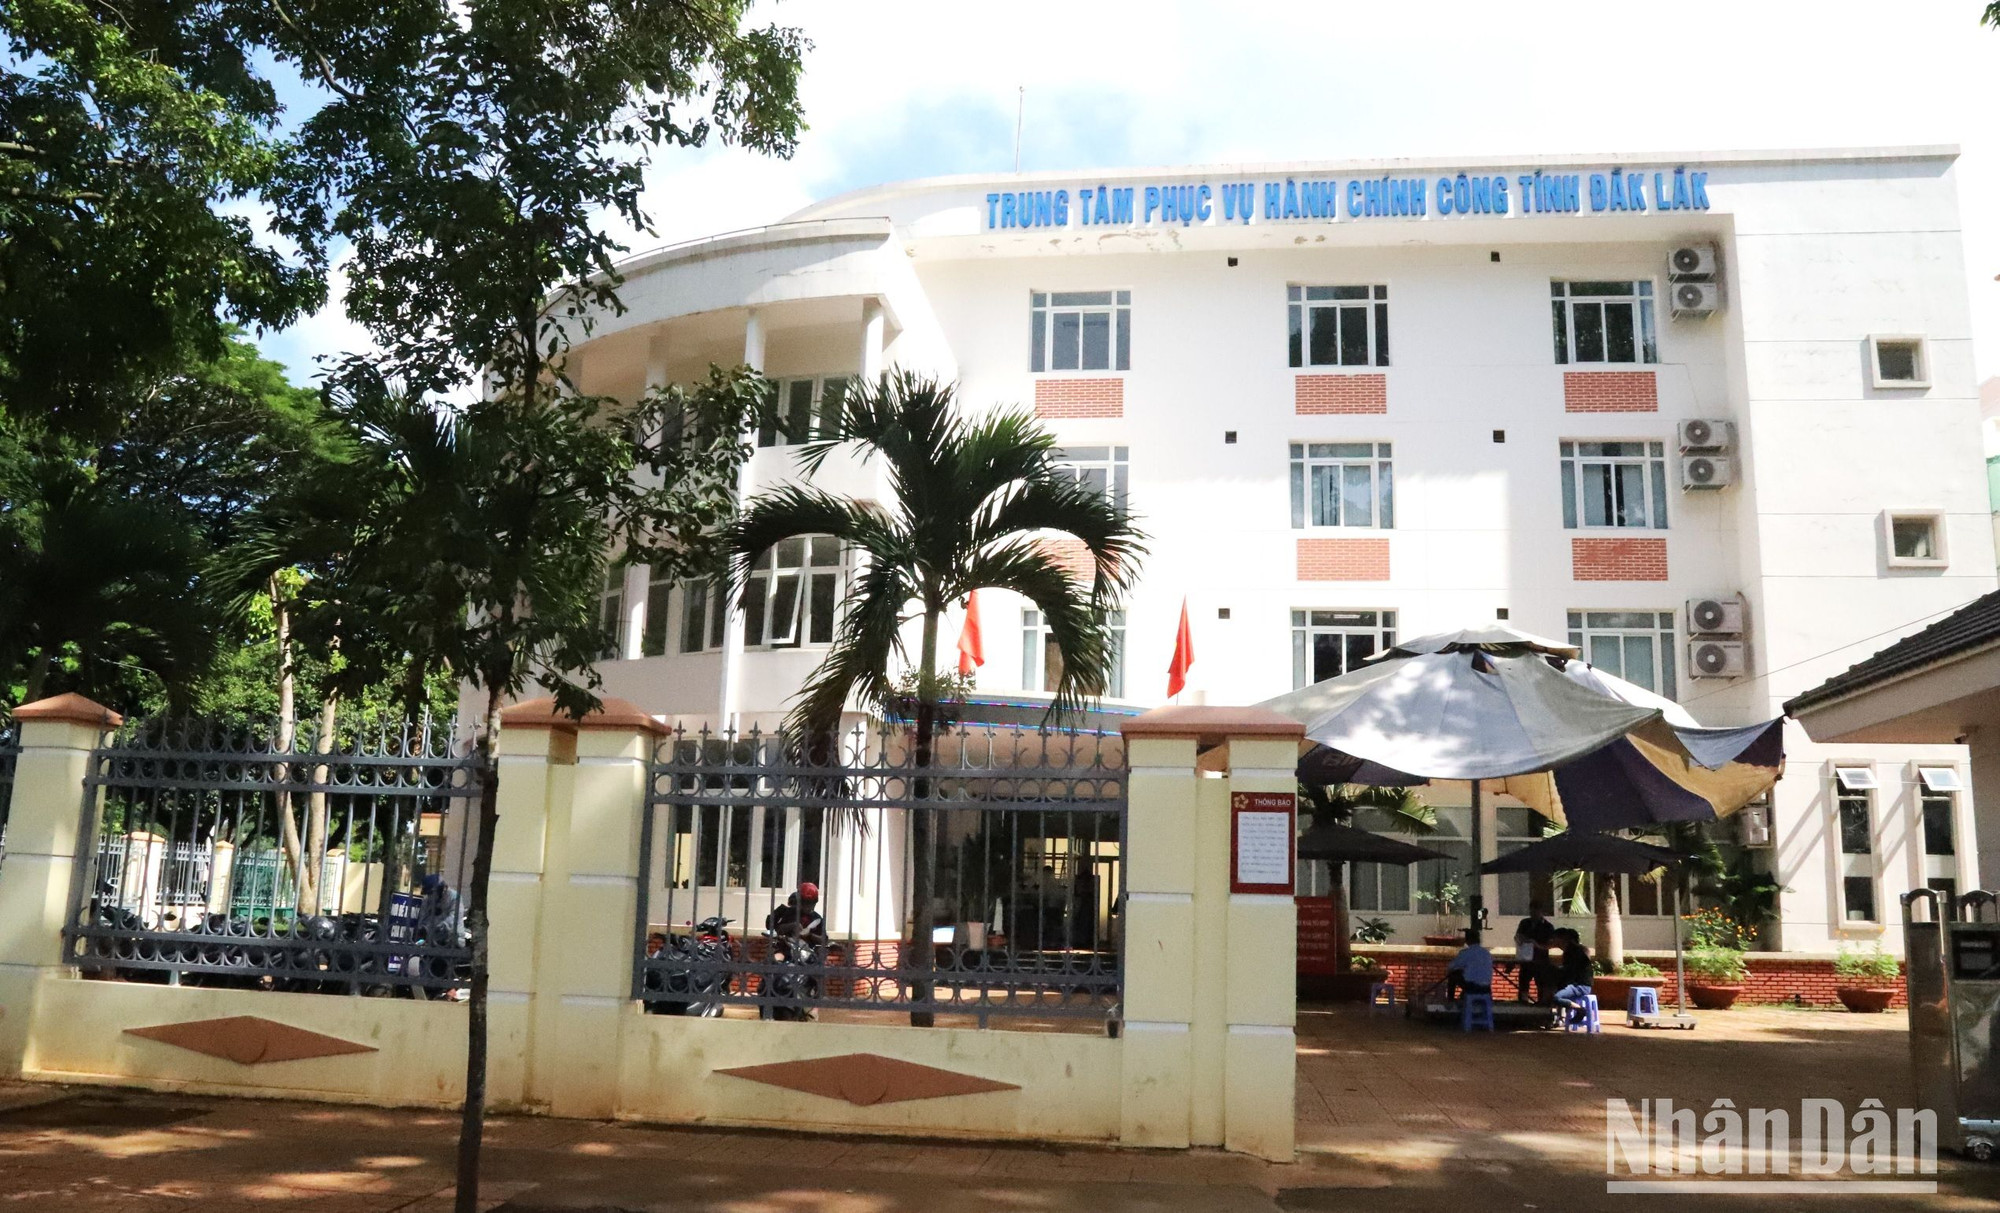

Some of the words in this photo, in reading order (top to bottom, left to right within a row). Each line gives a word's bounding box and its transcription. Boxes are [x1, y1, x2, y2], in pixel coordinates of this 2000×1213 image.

[987, 190, 1069, 229] TRUNG
[1080, 186, 1133, 225] TÂM
[1144, 184, 1211, 227] PHỤC
[1222, 183, 1254, 225] VỤ
[1264, 177, 1336, 219] HÀNH
[1347, 174, 1427, 217] CHÍNH
[1436, 171, 1508, 214] CÔNG
[1255, 798, 1276, 806] THÔNG
